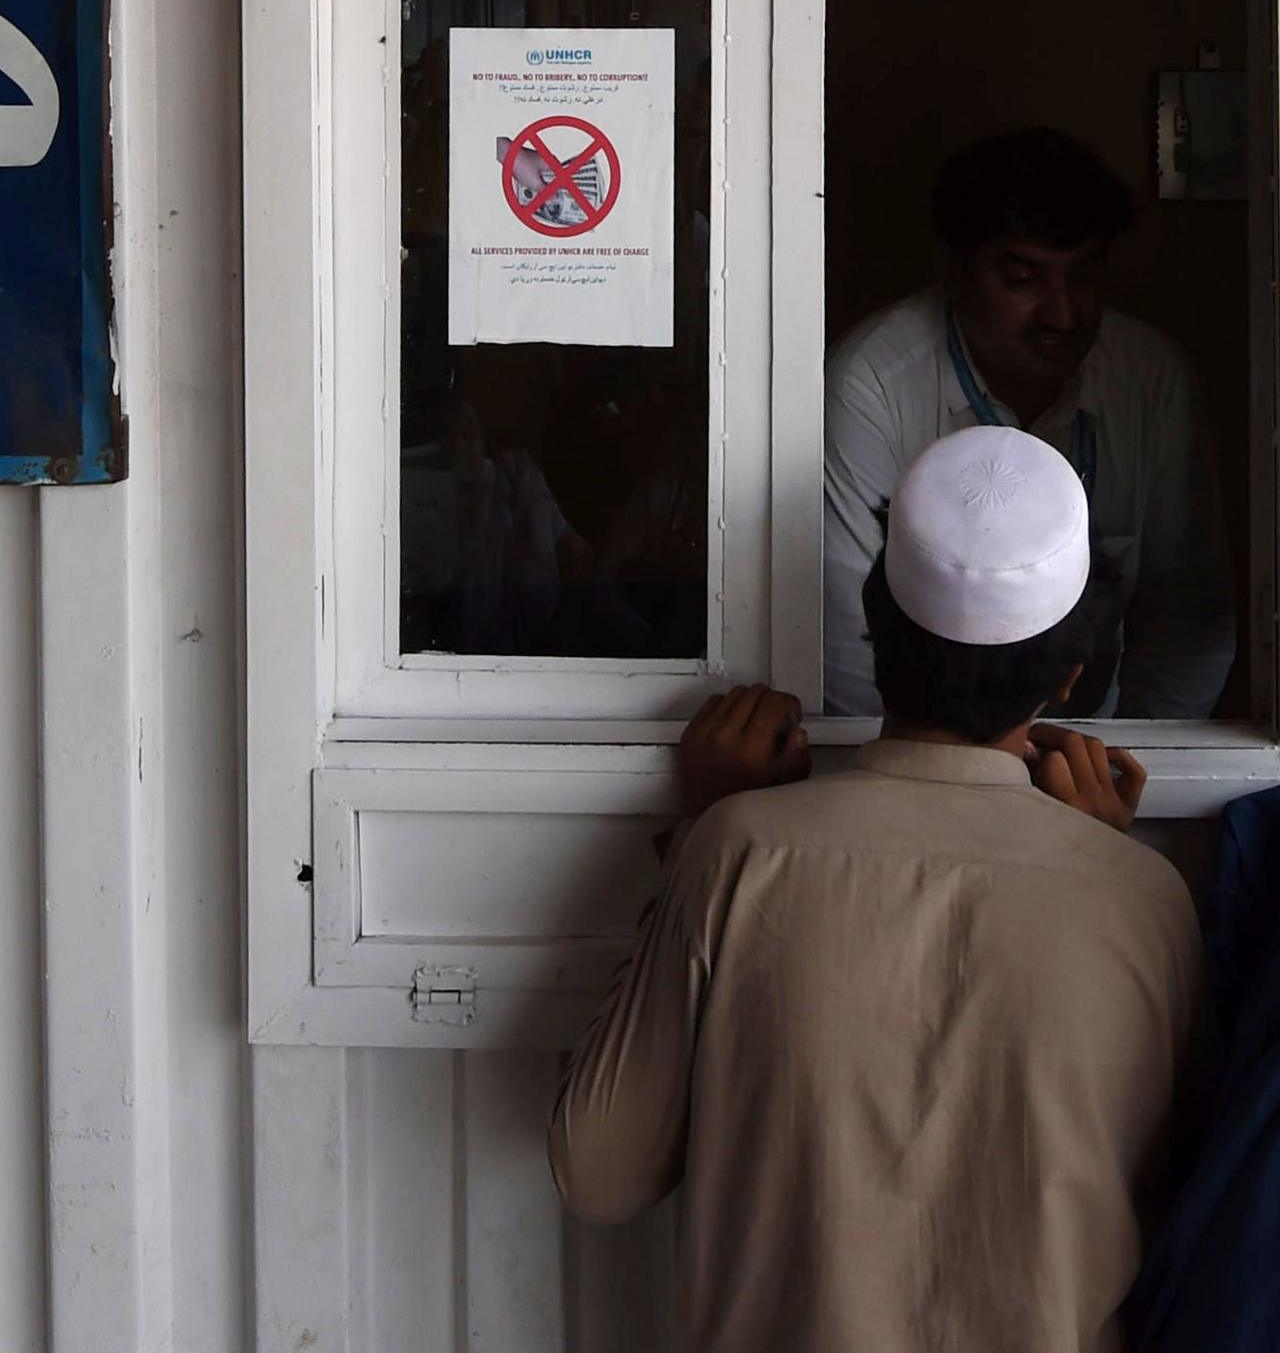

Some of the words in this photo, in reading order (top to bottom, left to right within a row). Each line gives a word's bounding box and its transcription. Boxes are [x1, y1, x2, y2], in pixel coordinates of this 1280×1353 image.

[546, 49, 592, 60] UNHCR
[472, 73, 483, 81] NO
[485, 73, 494, 81] TO
[523, 73, 534, 81] NO
[535, 73, 544, 81] TO
[577, 73, 588, 81] NO
[589, 73, 598, 81] TO
[471, 247, 482, 255] ALL
[483, 247, 513, 255] SERVICES
[515, 247, 547, 255] PROVIDED
[548, 247, 557, 255] BY
[558, 247, 581, 255] UNHCR
[582, 247, 595, 255] ARE
[596, 247, 611, 255] FREE
[613, 247, 622, 255] OF
[623, 247, 650, 255] CHARGE
